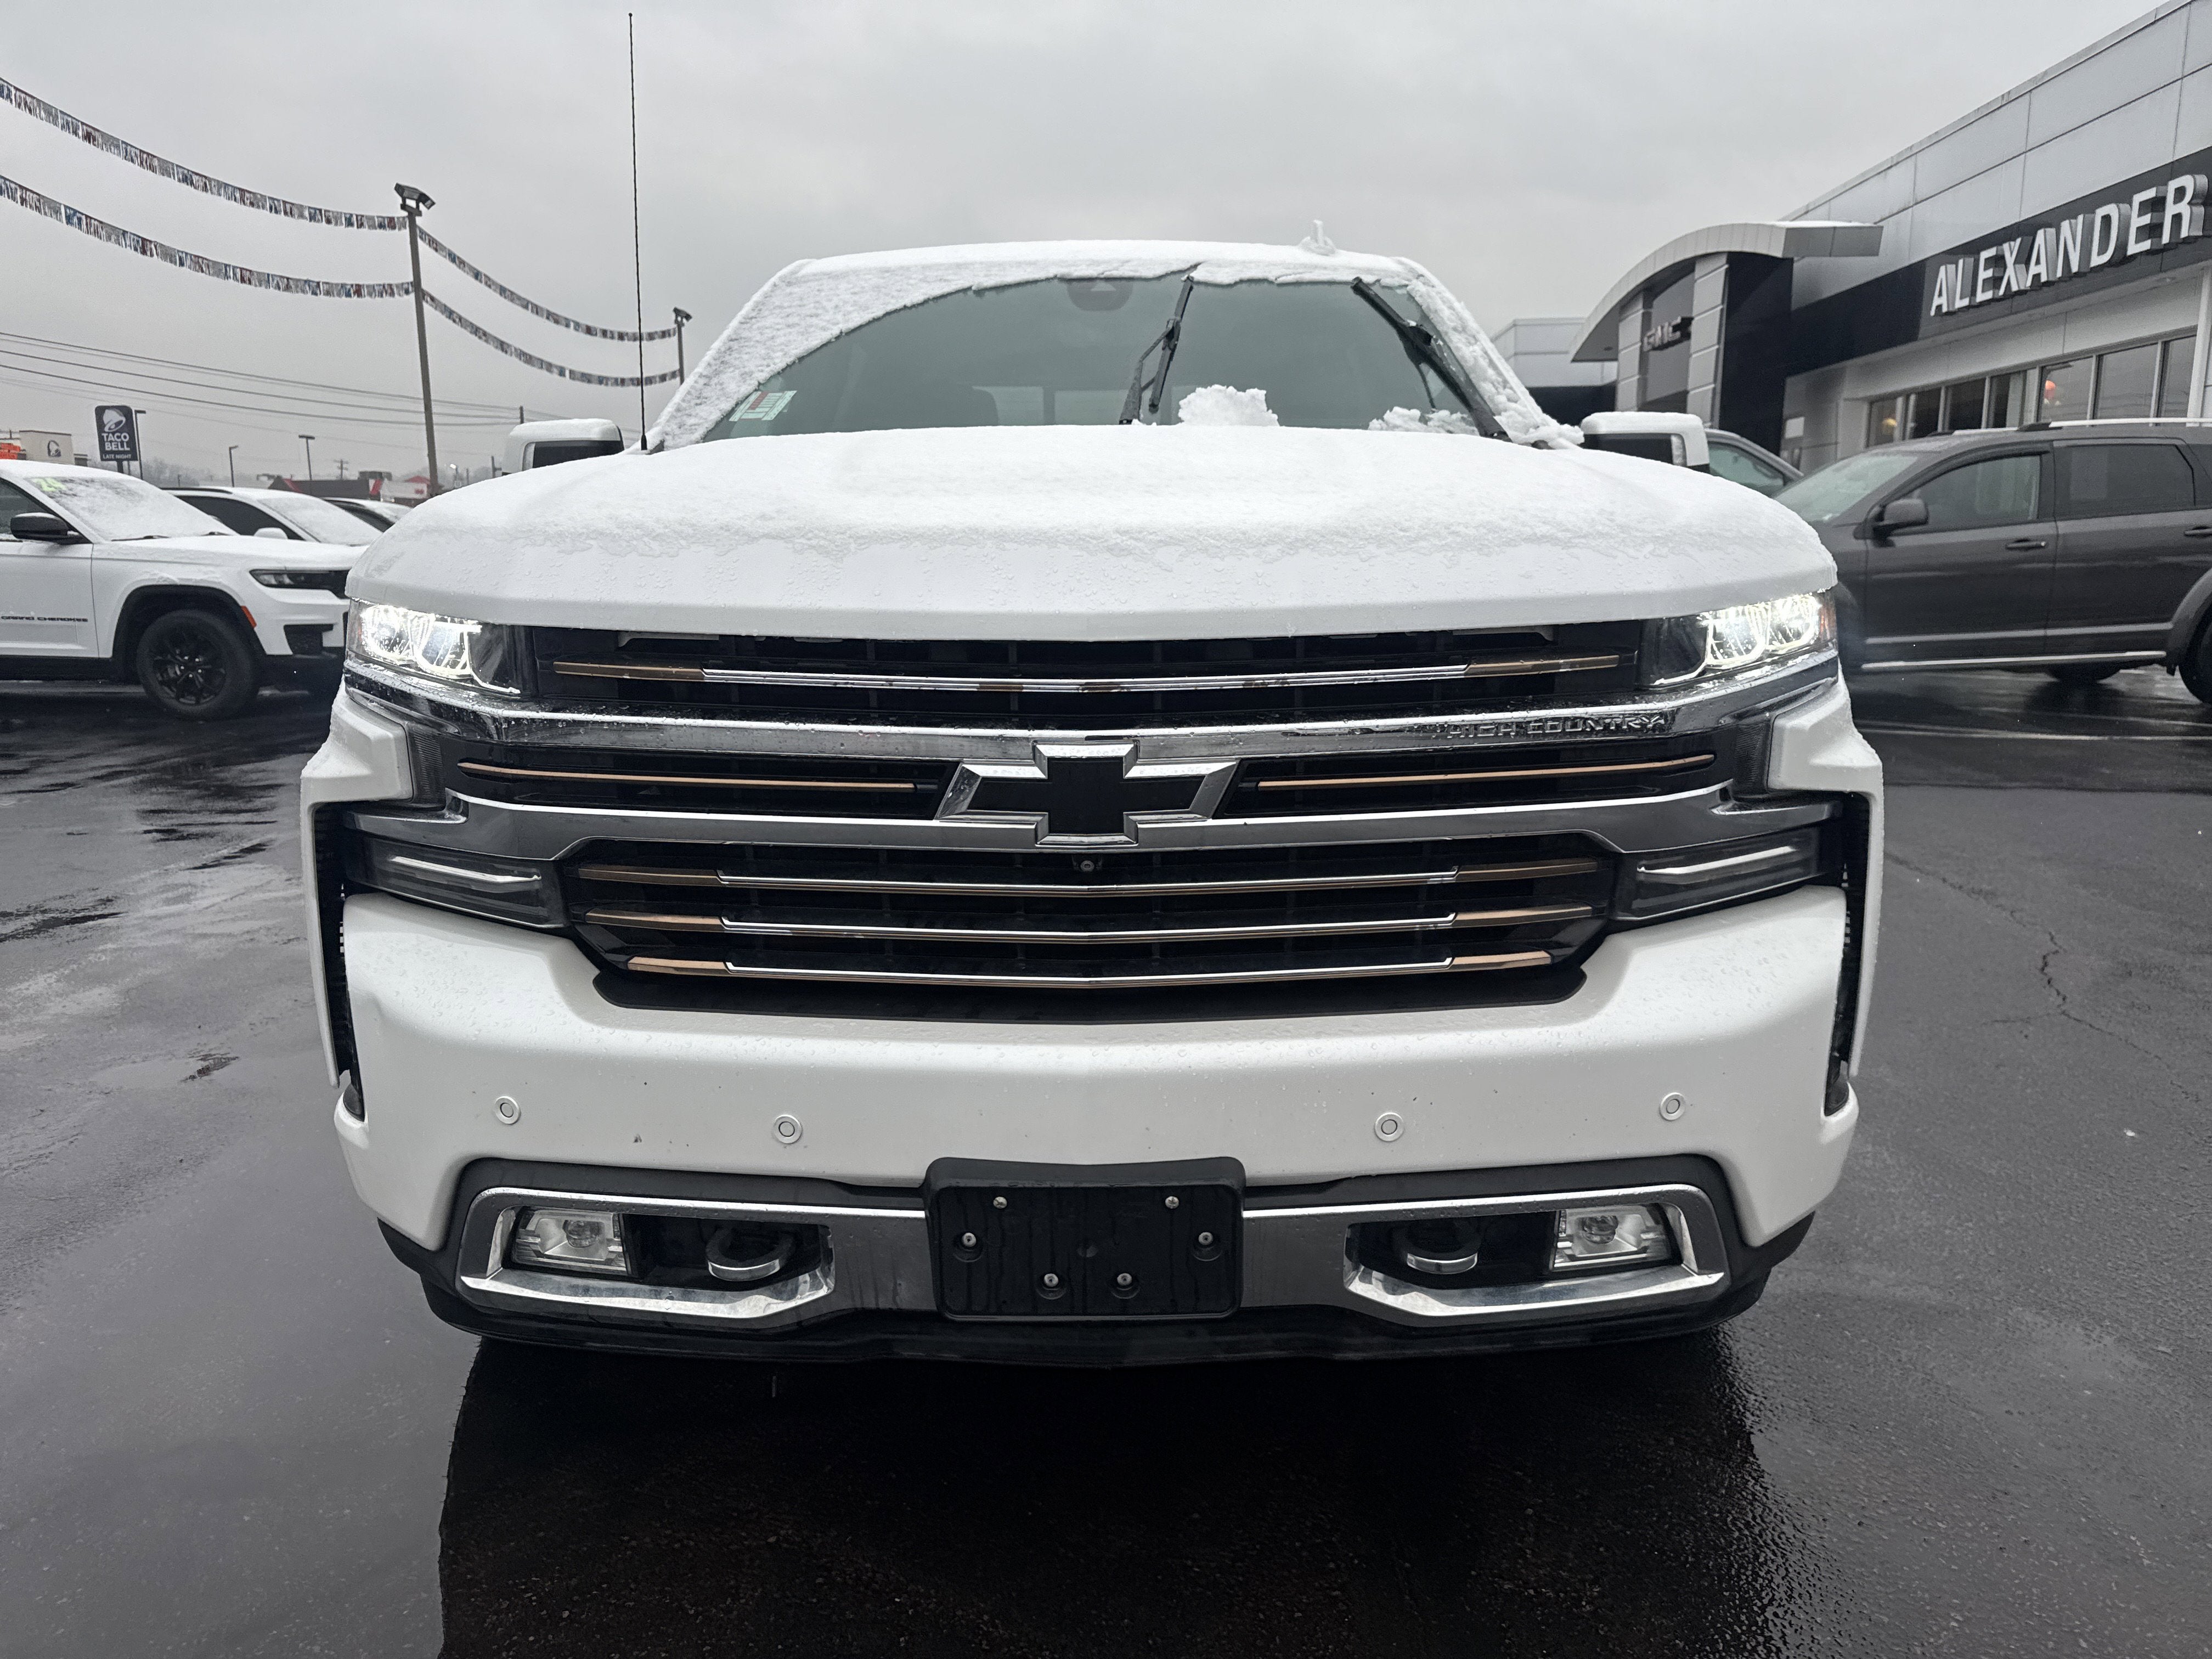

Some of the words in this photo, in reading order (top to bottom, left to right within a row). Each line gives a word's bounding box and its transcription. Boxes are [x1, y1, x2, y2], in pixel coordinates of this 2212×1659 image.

[1931, 174, 2208, 317] ALEXANDER
[1643, 316, 1681, 352] GMC
[101, 432, 129, 442] TACO
[105, 442, 131, 450] BELL
[1527, 715, 1665, 734] COUNTRY
